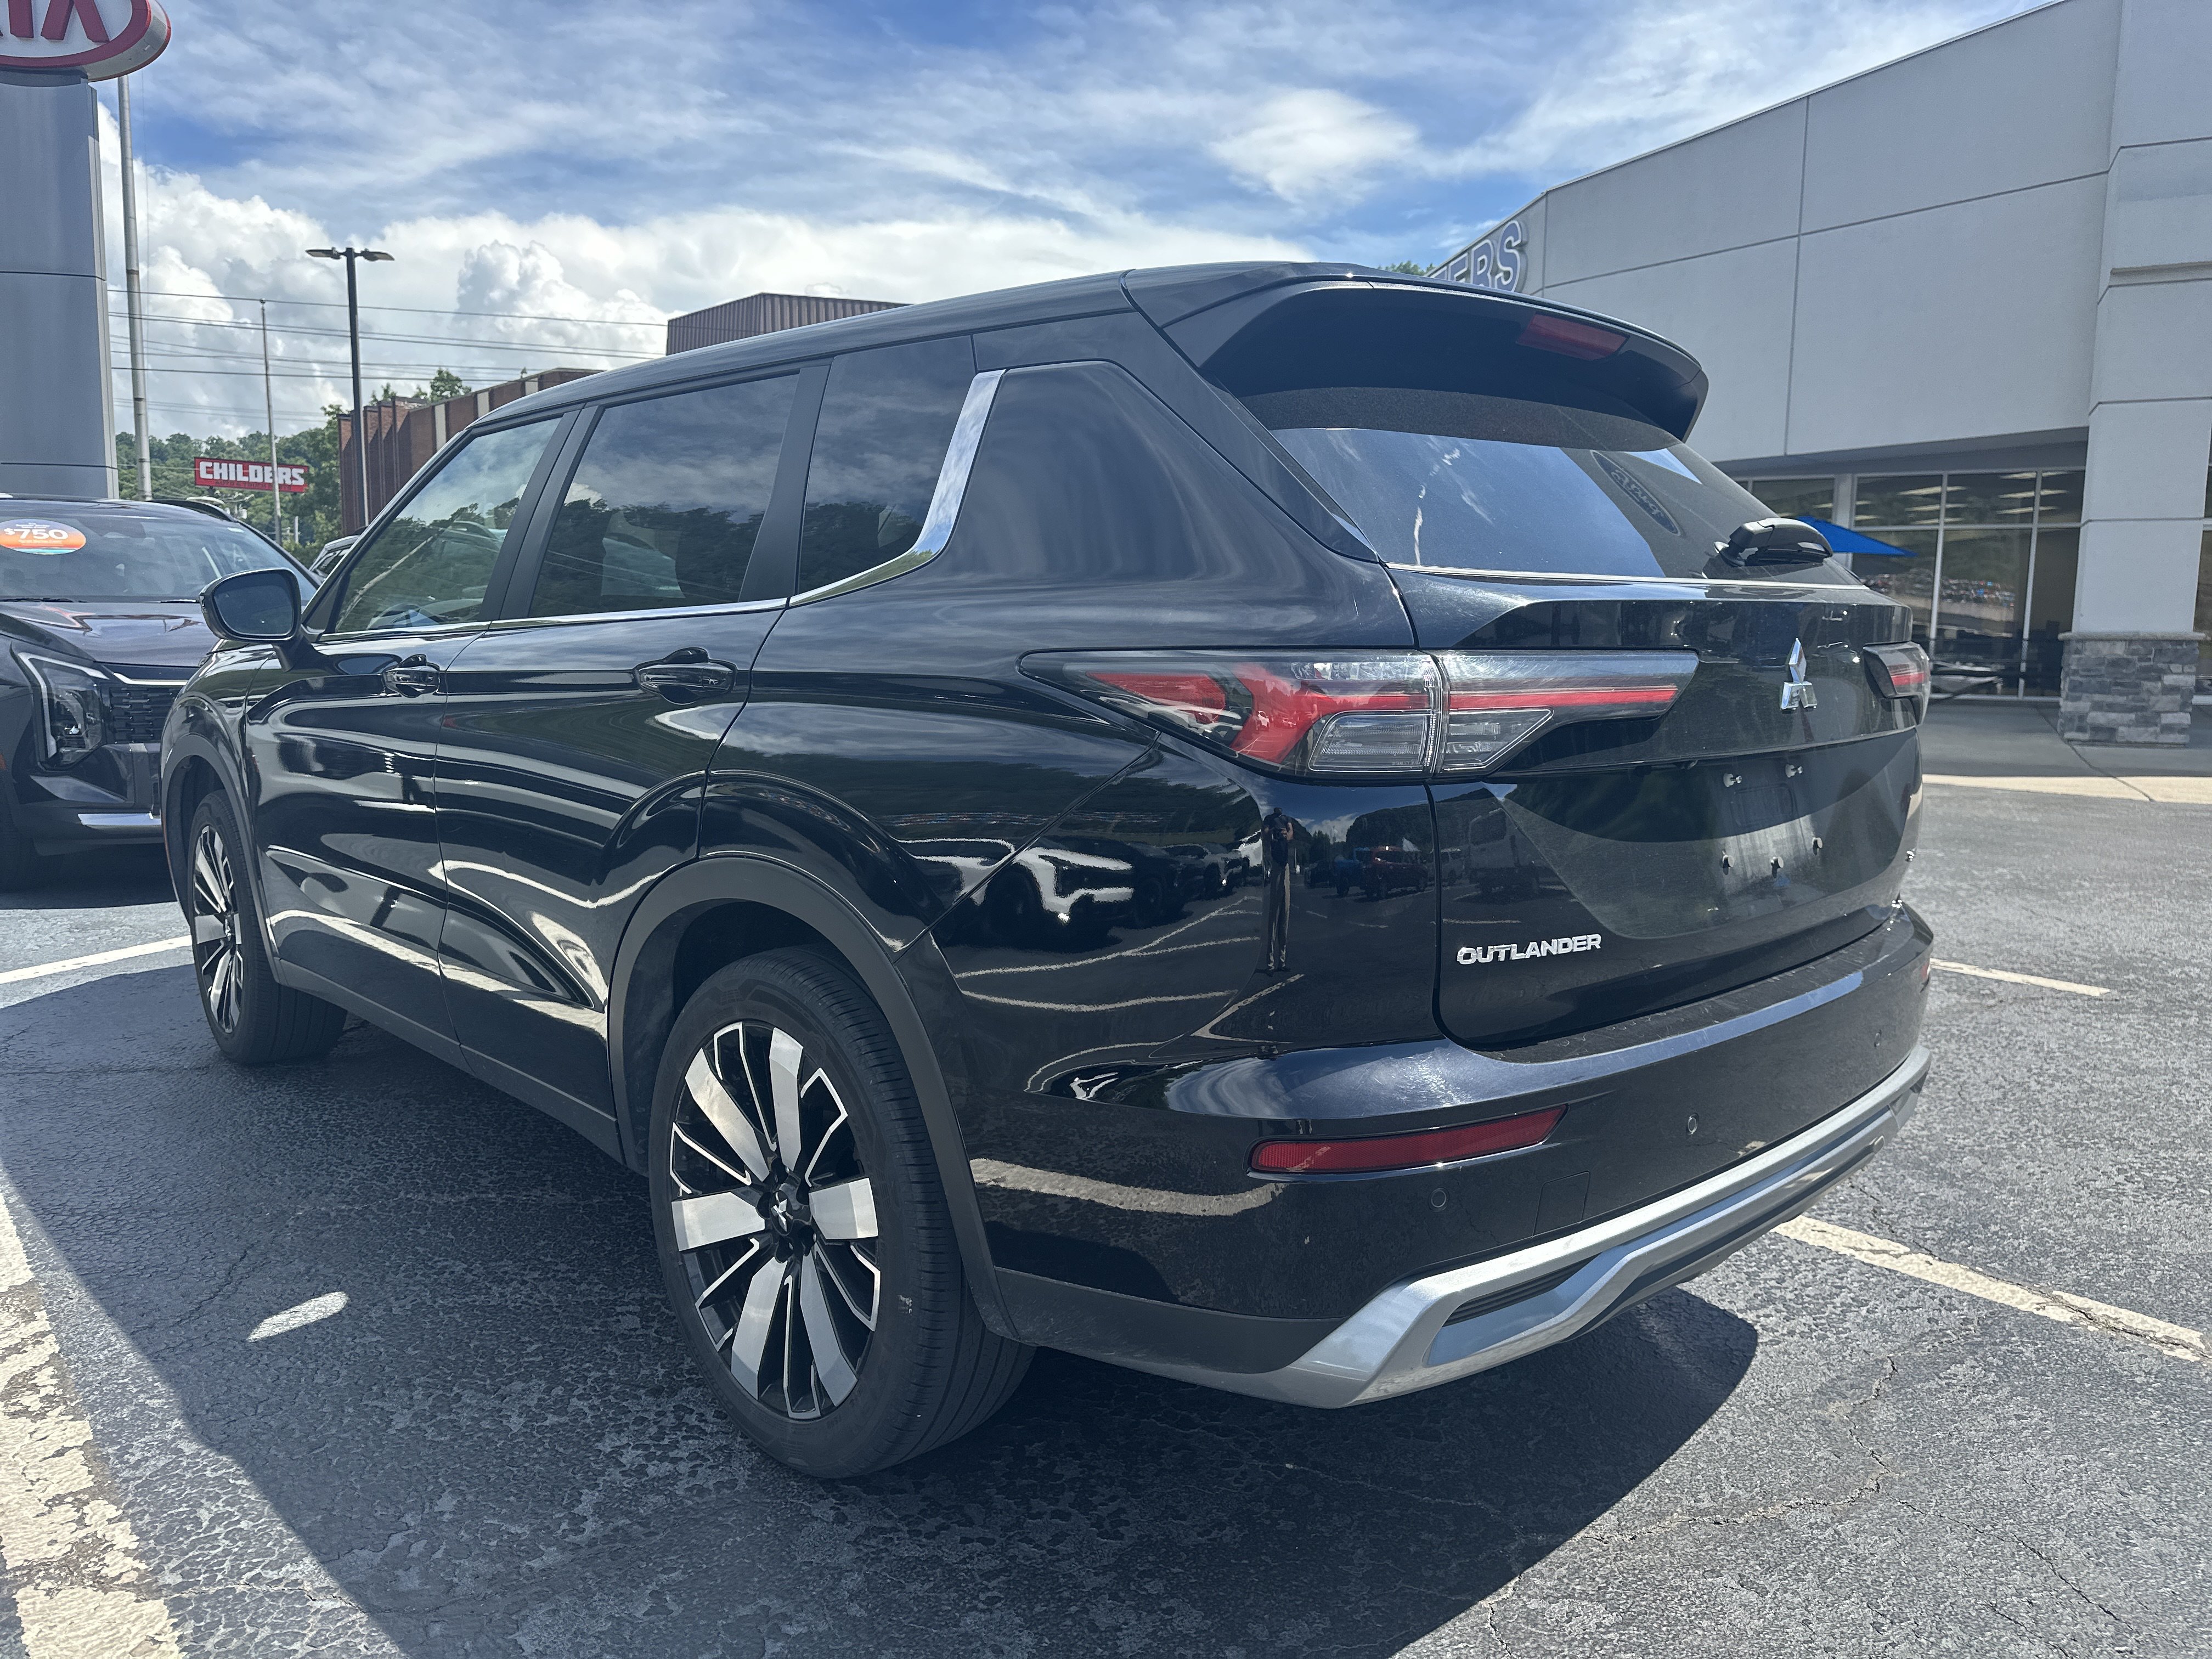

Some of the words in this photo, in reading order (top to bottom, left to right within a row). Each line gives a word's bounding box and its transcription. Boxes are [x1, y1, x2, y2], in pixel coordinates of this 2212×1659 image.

[0, 0, 110, 43] IA
[200, 461, 305, 486] CHILDERS
[4, 528, 68, 540] $750
[1457, 934, 1601, 964] OUTLANDER
